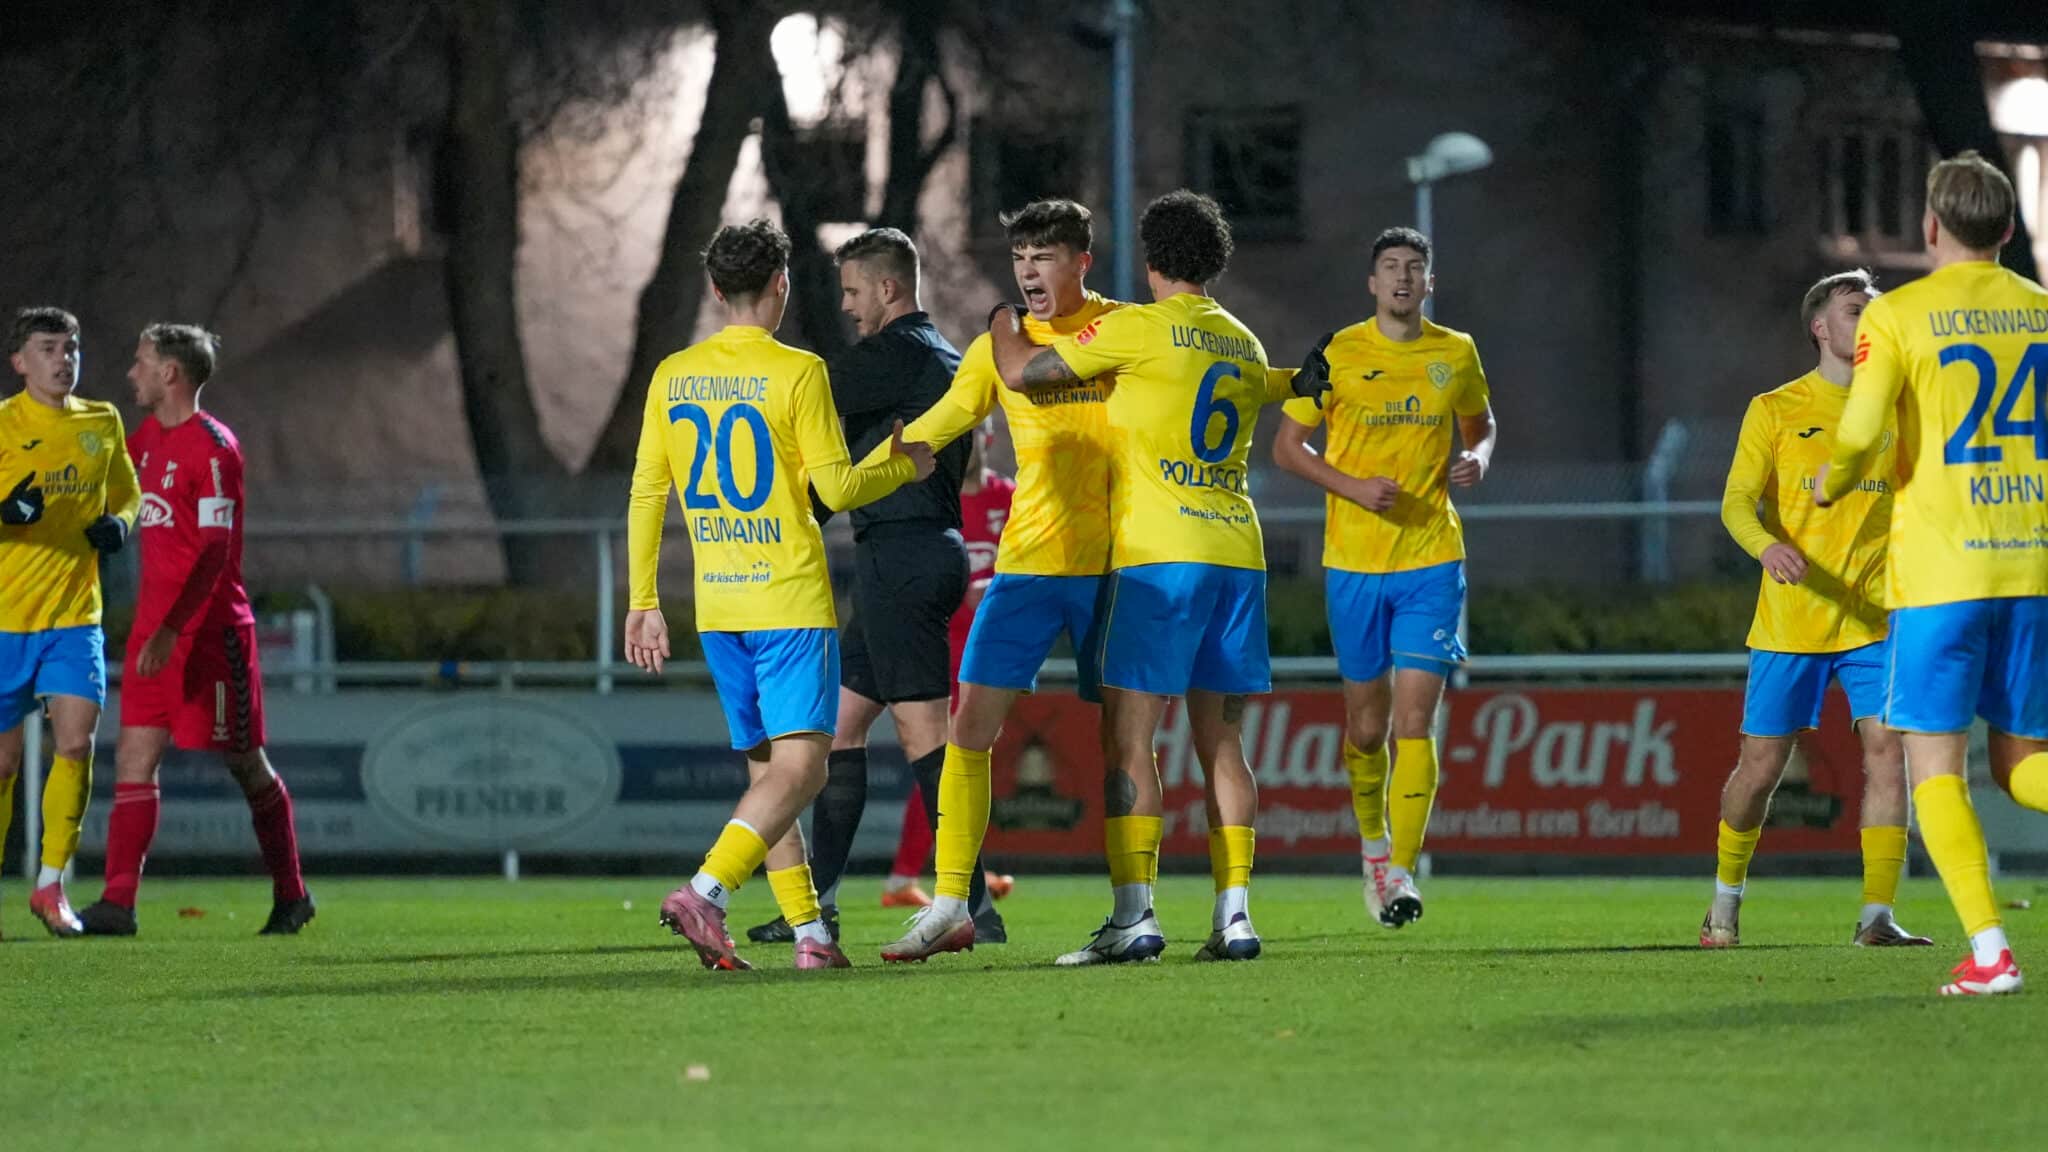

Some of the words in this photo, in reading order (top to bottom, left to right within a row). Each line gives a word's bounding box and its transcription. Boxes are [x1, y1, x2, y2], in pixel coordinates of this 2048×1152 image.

[1929, 308, 2048, 336] LUCKENWALD
[667, 375, 768, 401] LUCKENWALDE
[1030, 391, 1105, 405] LUCKENWAL
[1938, 342, 2048, 465] 24
[1190, 361, 1242, 464] 6
[668, 403, 775, 513] 20
[1970, 467, 2044, 506] KÜHN
